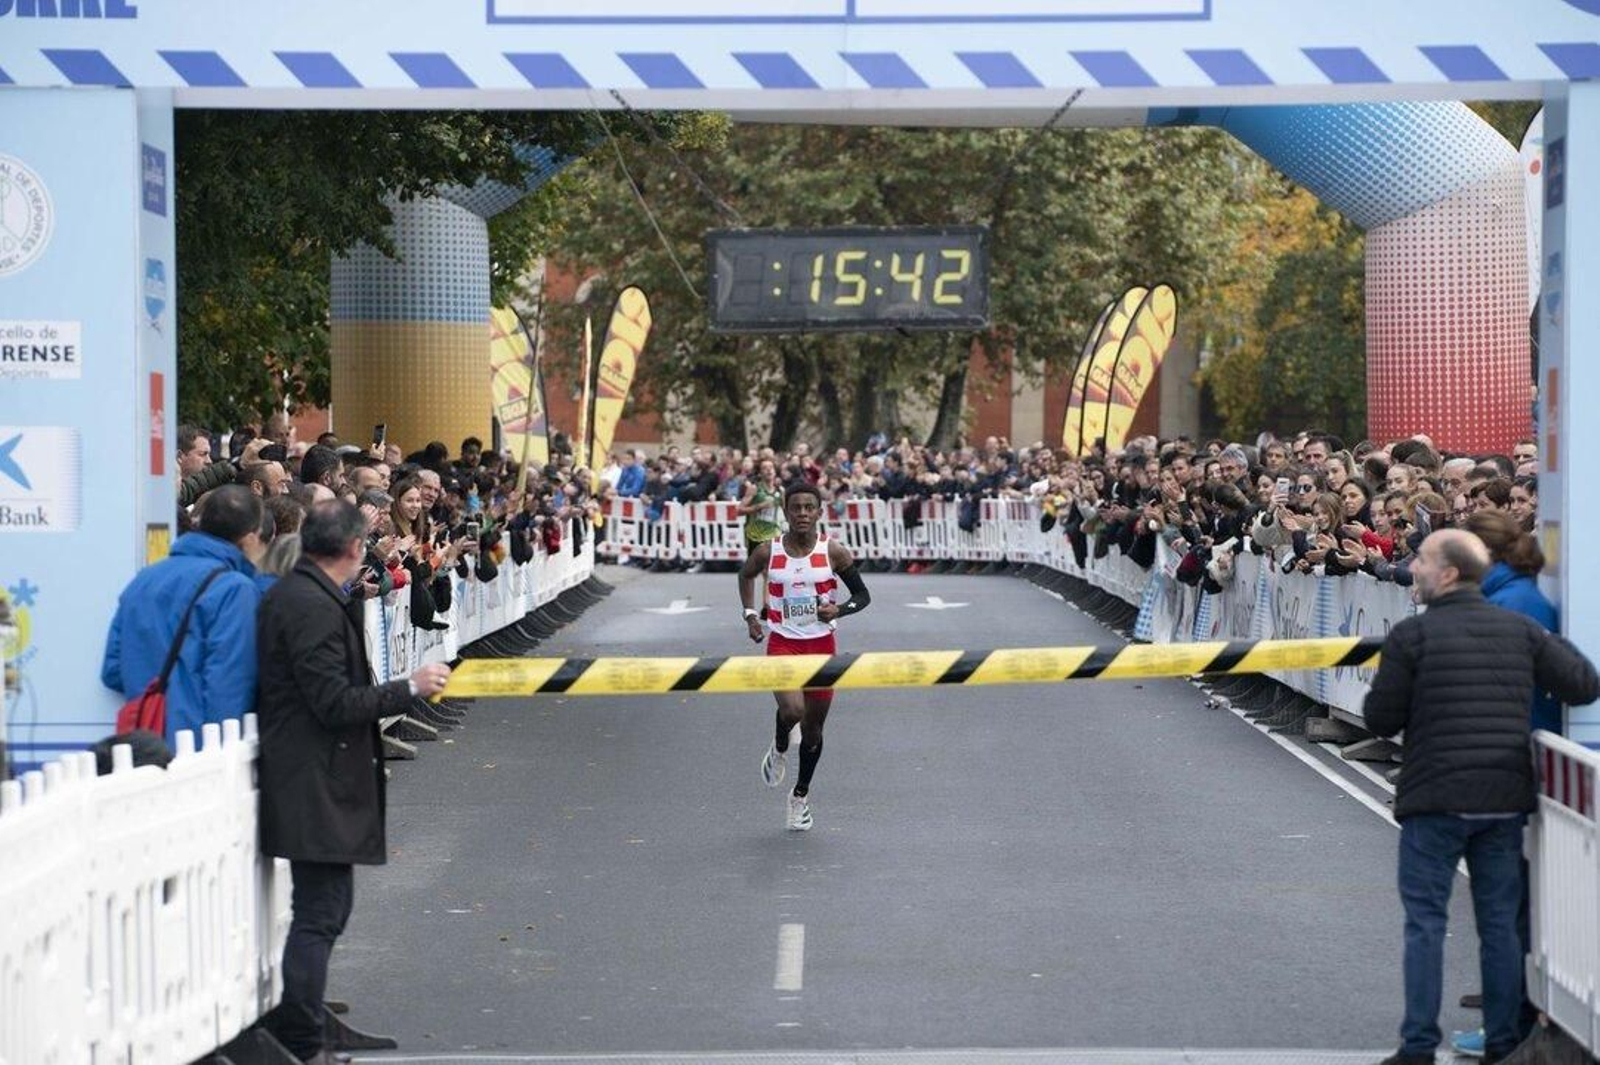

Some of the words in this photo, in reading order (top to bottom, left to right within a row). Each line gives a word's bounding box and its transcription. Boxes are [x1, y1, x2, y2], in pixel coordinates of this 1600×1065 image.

[39, 324, 58, 339] de
[2, 344, 75, 362] RENSE
[0, 505, 49, 526] Bank
[791, 604, 816, 617] 8045
